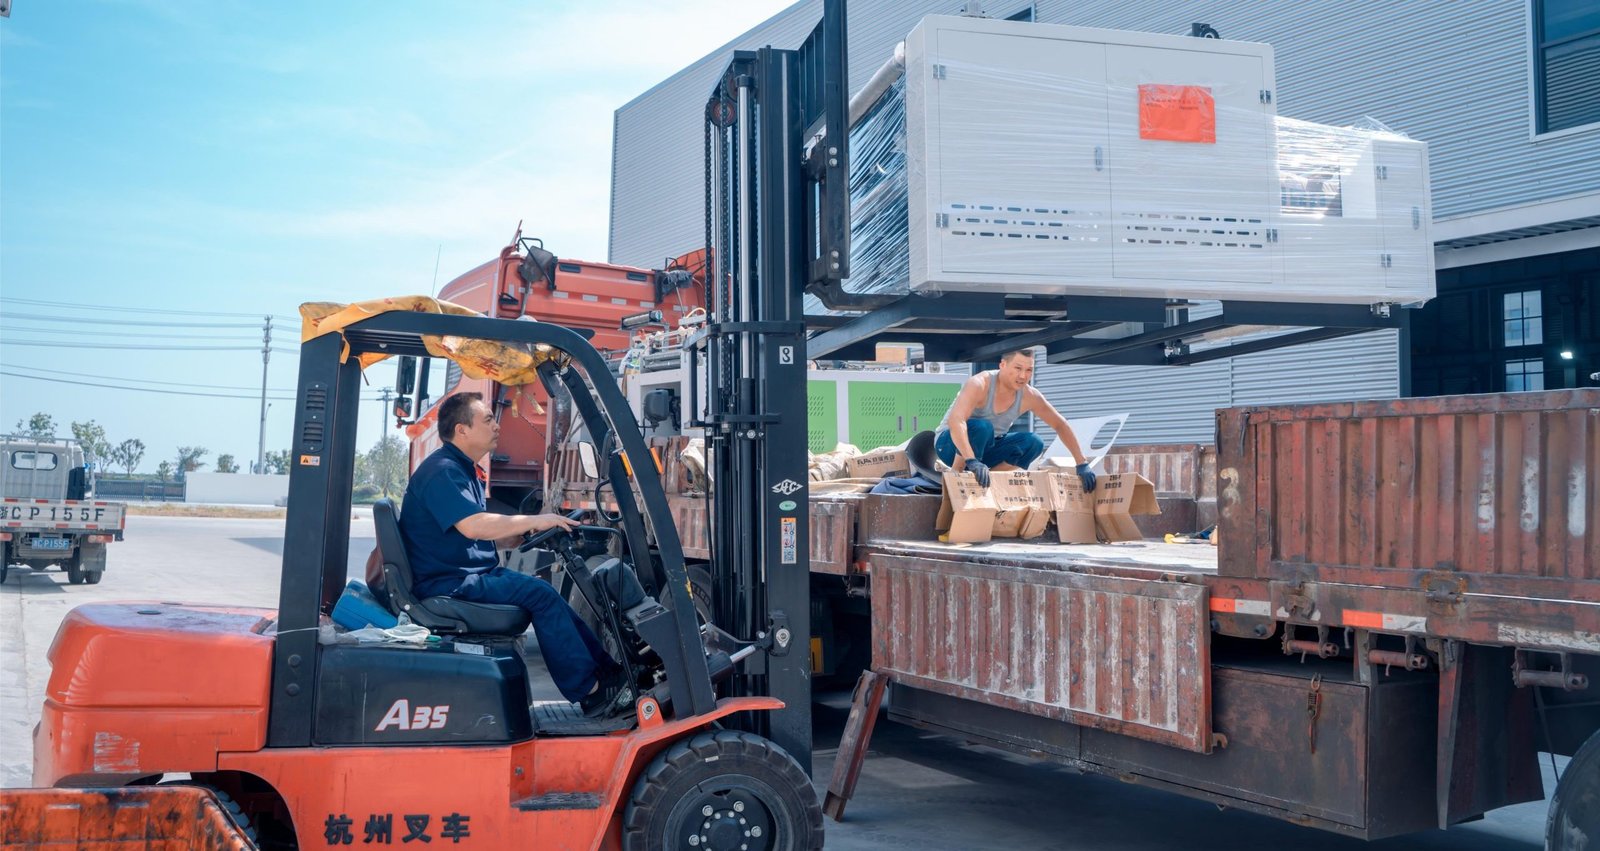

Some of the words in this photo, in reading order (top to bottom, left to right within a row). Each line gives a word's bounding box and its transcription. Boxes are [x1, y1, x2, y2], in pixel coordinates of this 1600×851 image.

[374, 698, 450, 731] A35
[324, 812, 470, 845] 杭州叉车
